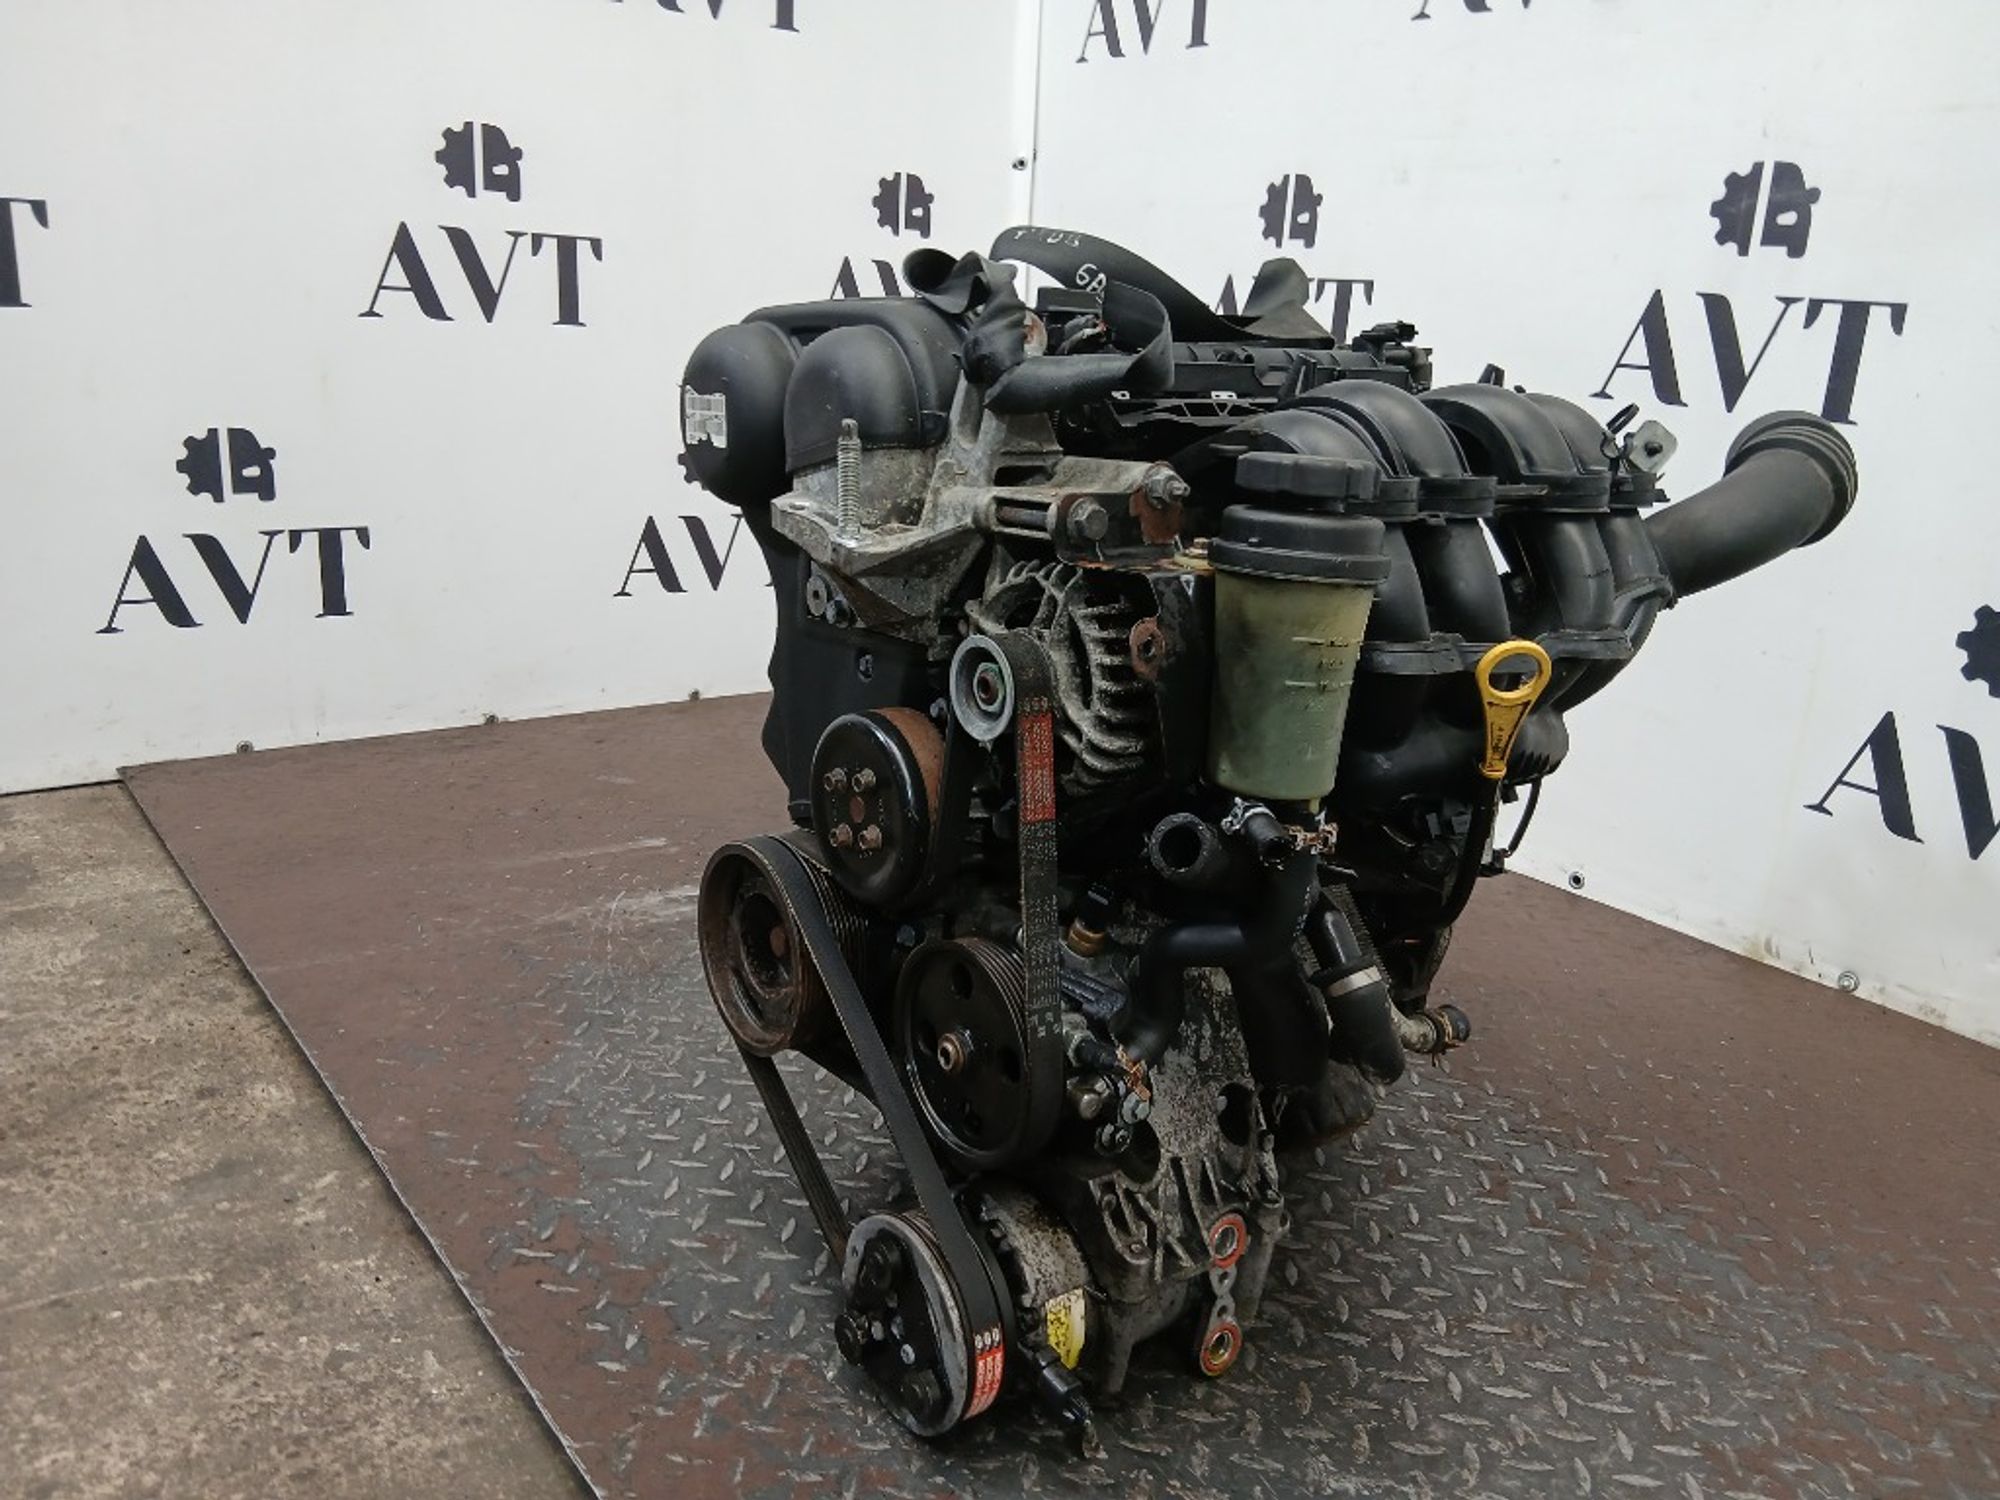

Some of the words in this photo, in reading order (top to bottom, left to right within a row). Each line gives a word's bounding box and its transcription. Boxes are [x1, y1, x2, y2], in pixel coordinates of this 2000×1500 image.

[358, 221, 603, 327] AVT
[1588, 288, 1908, 425] AVT
[95, 525, 371, 635] AVT
